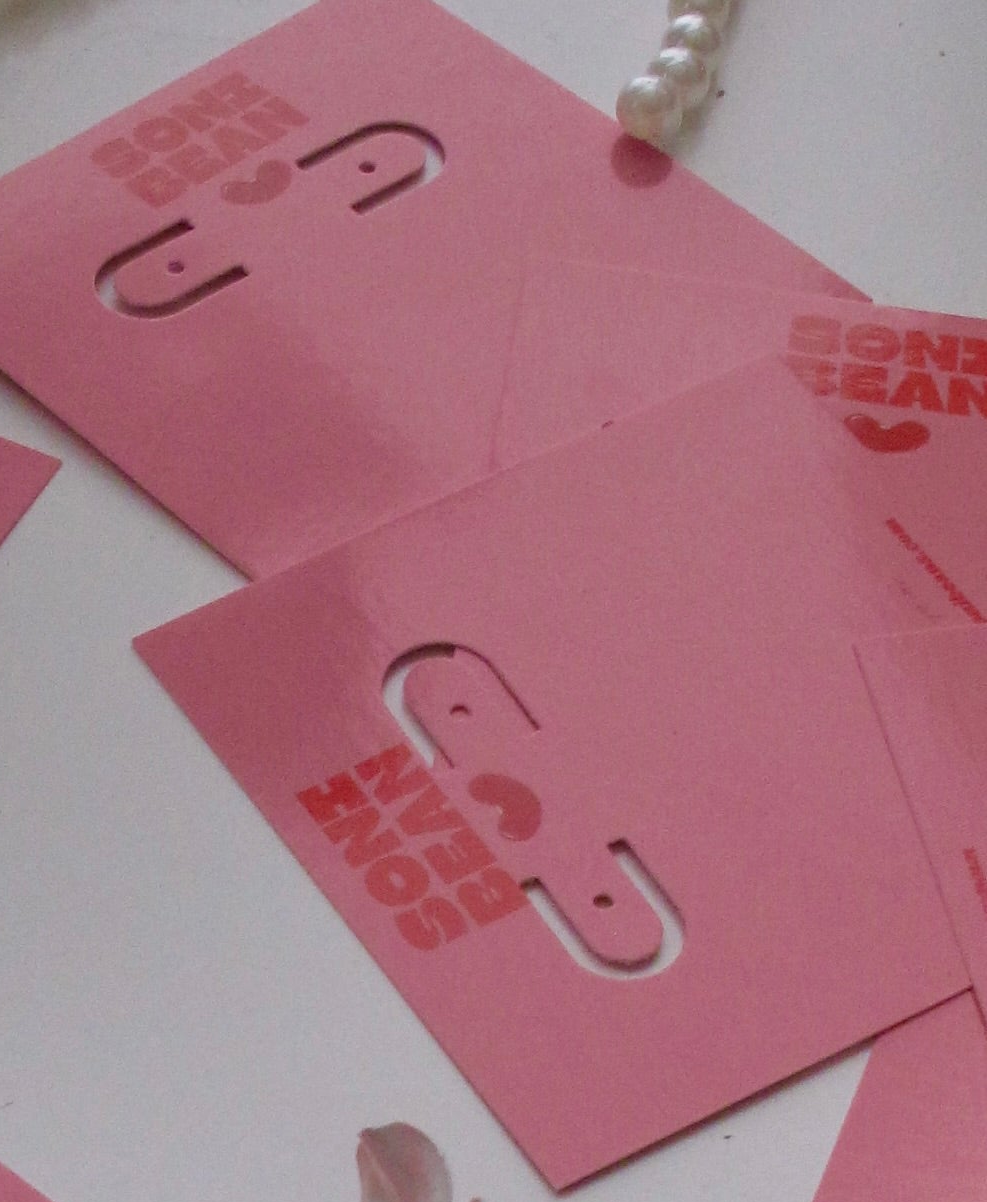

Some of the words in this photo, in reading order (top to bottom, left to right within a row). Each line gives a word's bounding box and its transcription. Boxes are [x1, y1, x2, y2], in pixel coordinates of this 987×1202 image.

[90, 72, 272, 178] SONI
[124, 96, 310, 208] BEAN
[296, 770, 469, 950] SONI
[354, 743, 530, 928] BEAN
